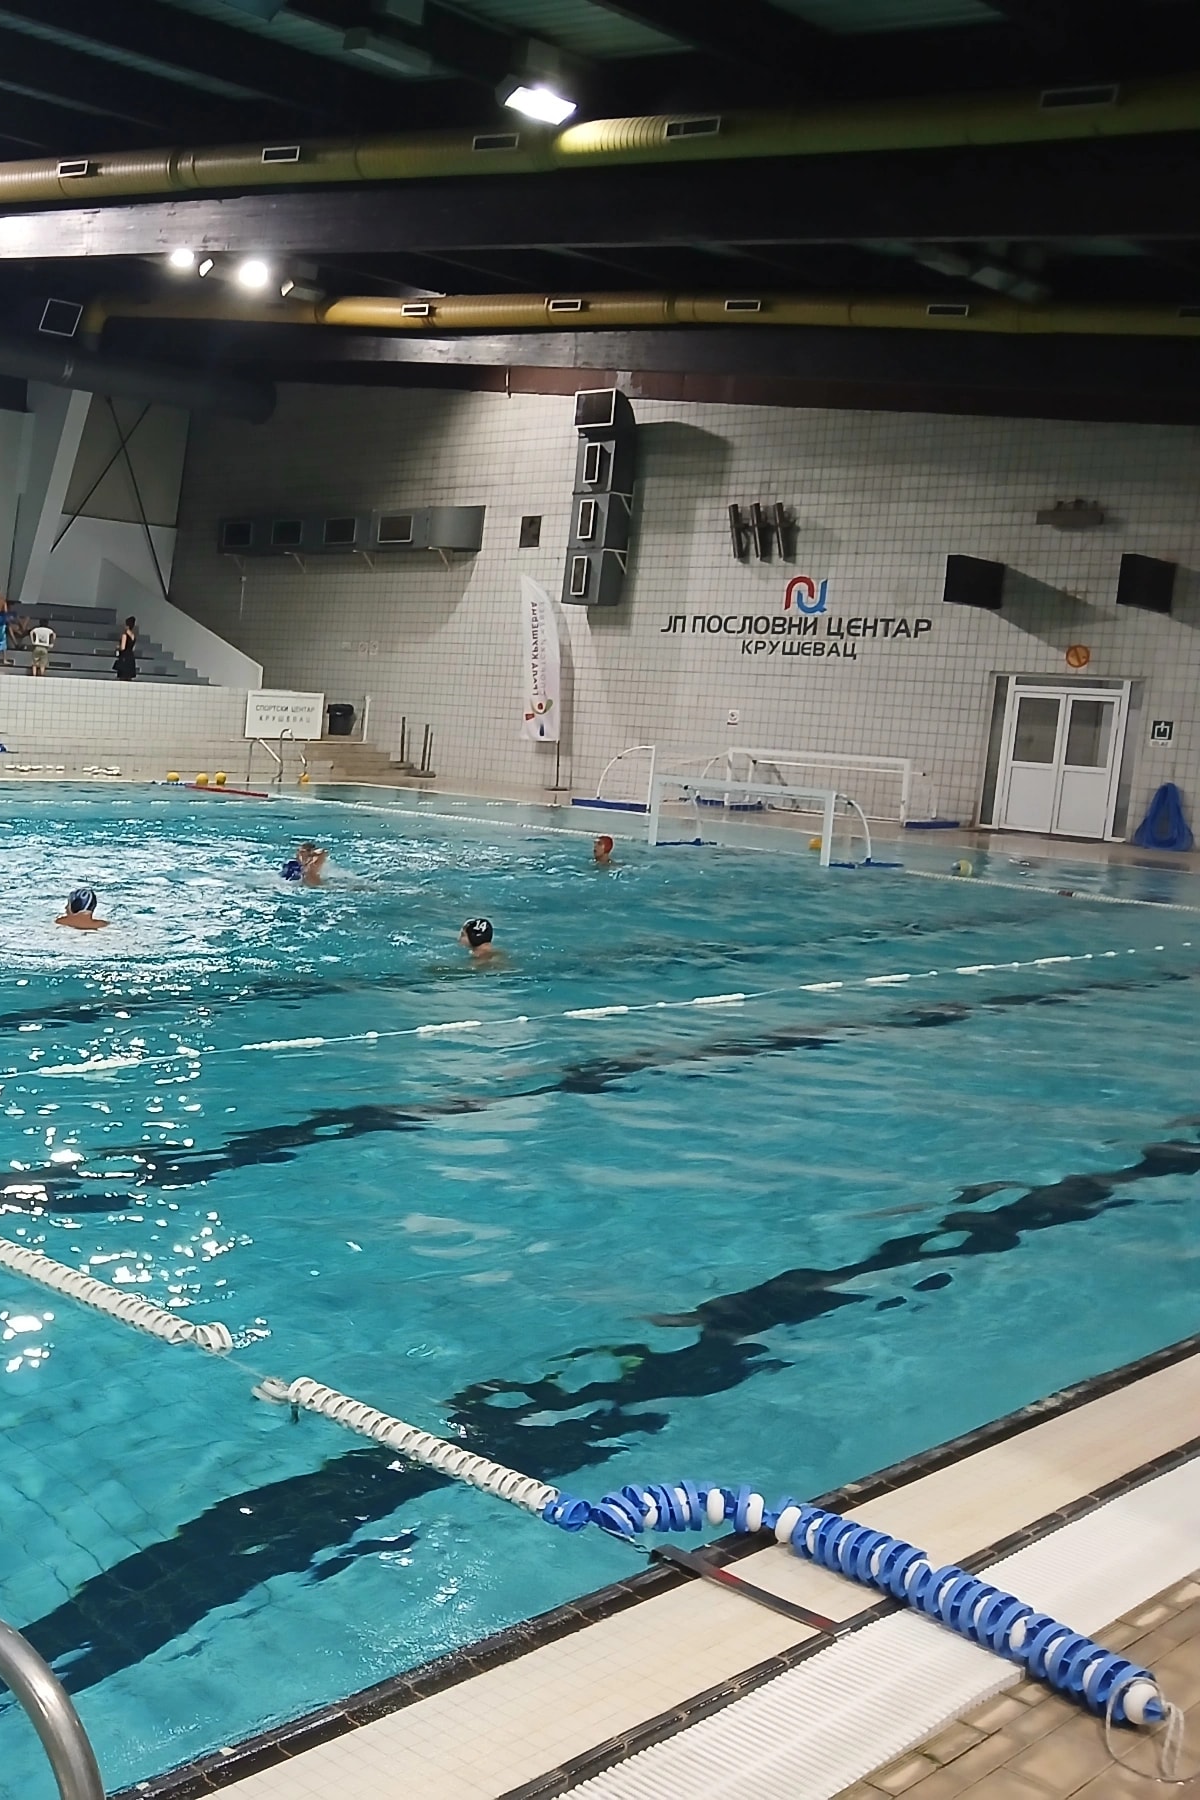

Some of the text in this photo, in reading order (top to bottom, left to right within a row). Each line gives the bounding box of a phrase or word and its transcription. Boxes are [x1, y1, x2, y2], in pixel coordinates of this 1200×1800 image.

[691, 615, 819, 637] ПОСЛОВНИ
[826, 617, 933, 640] ЦЕНТАР
[741, 640, 858, 661] КРУШЕВАЦ
[255, 704, 289, 712] СПОРТСКИ
[473, 919, 487, 932] 14
